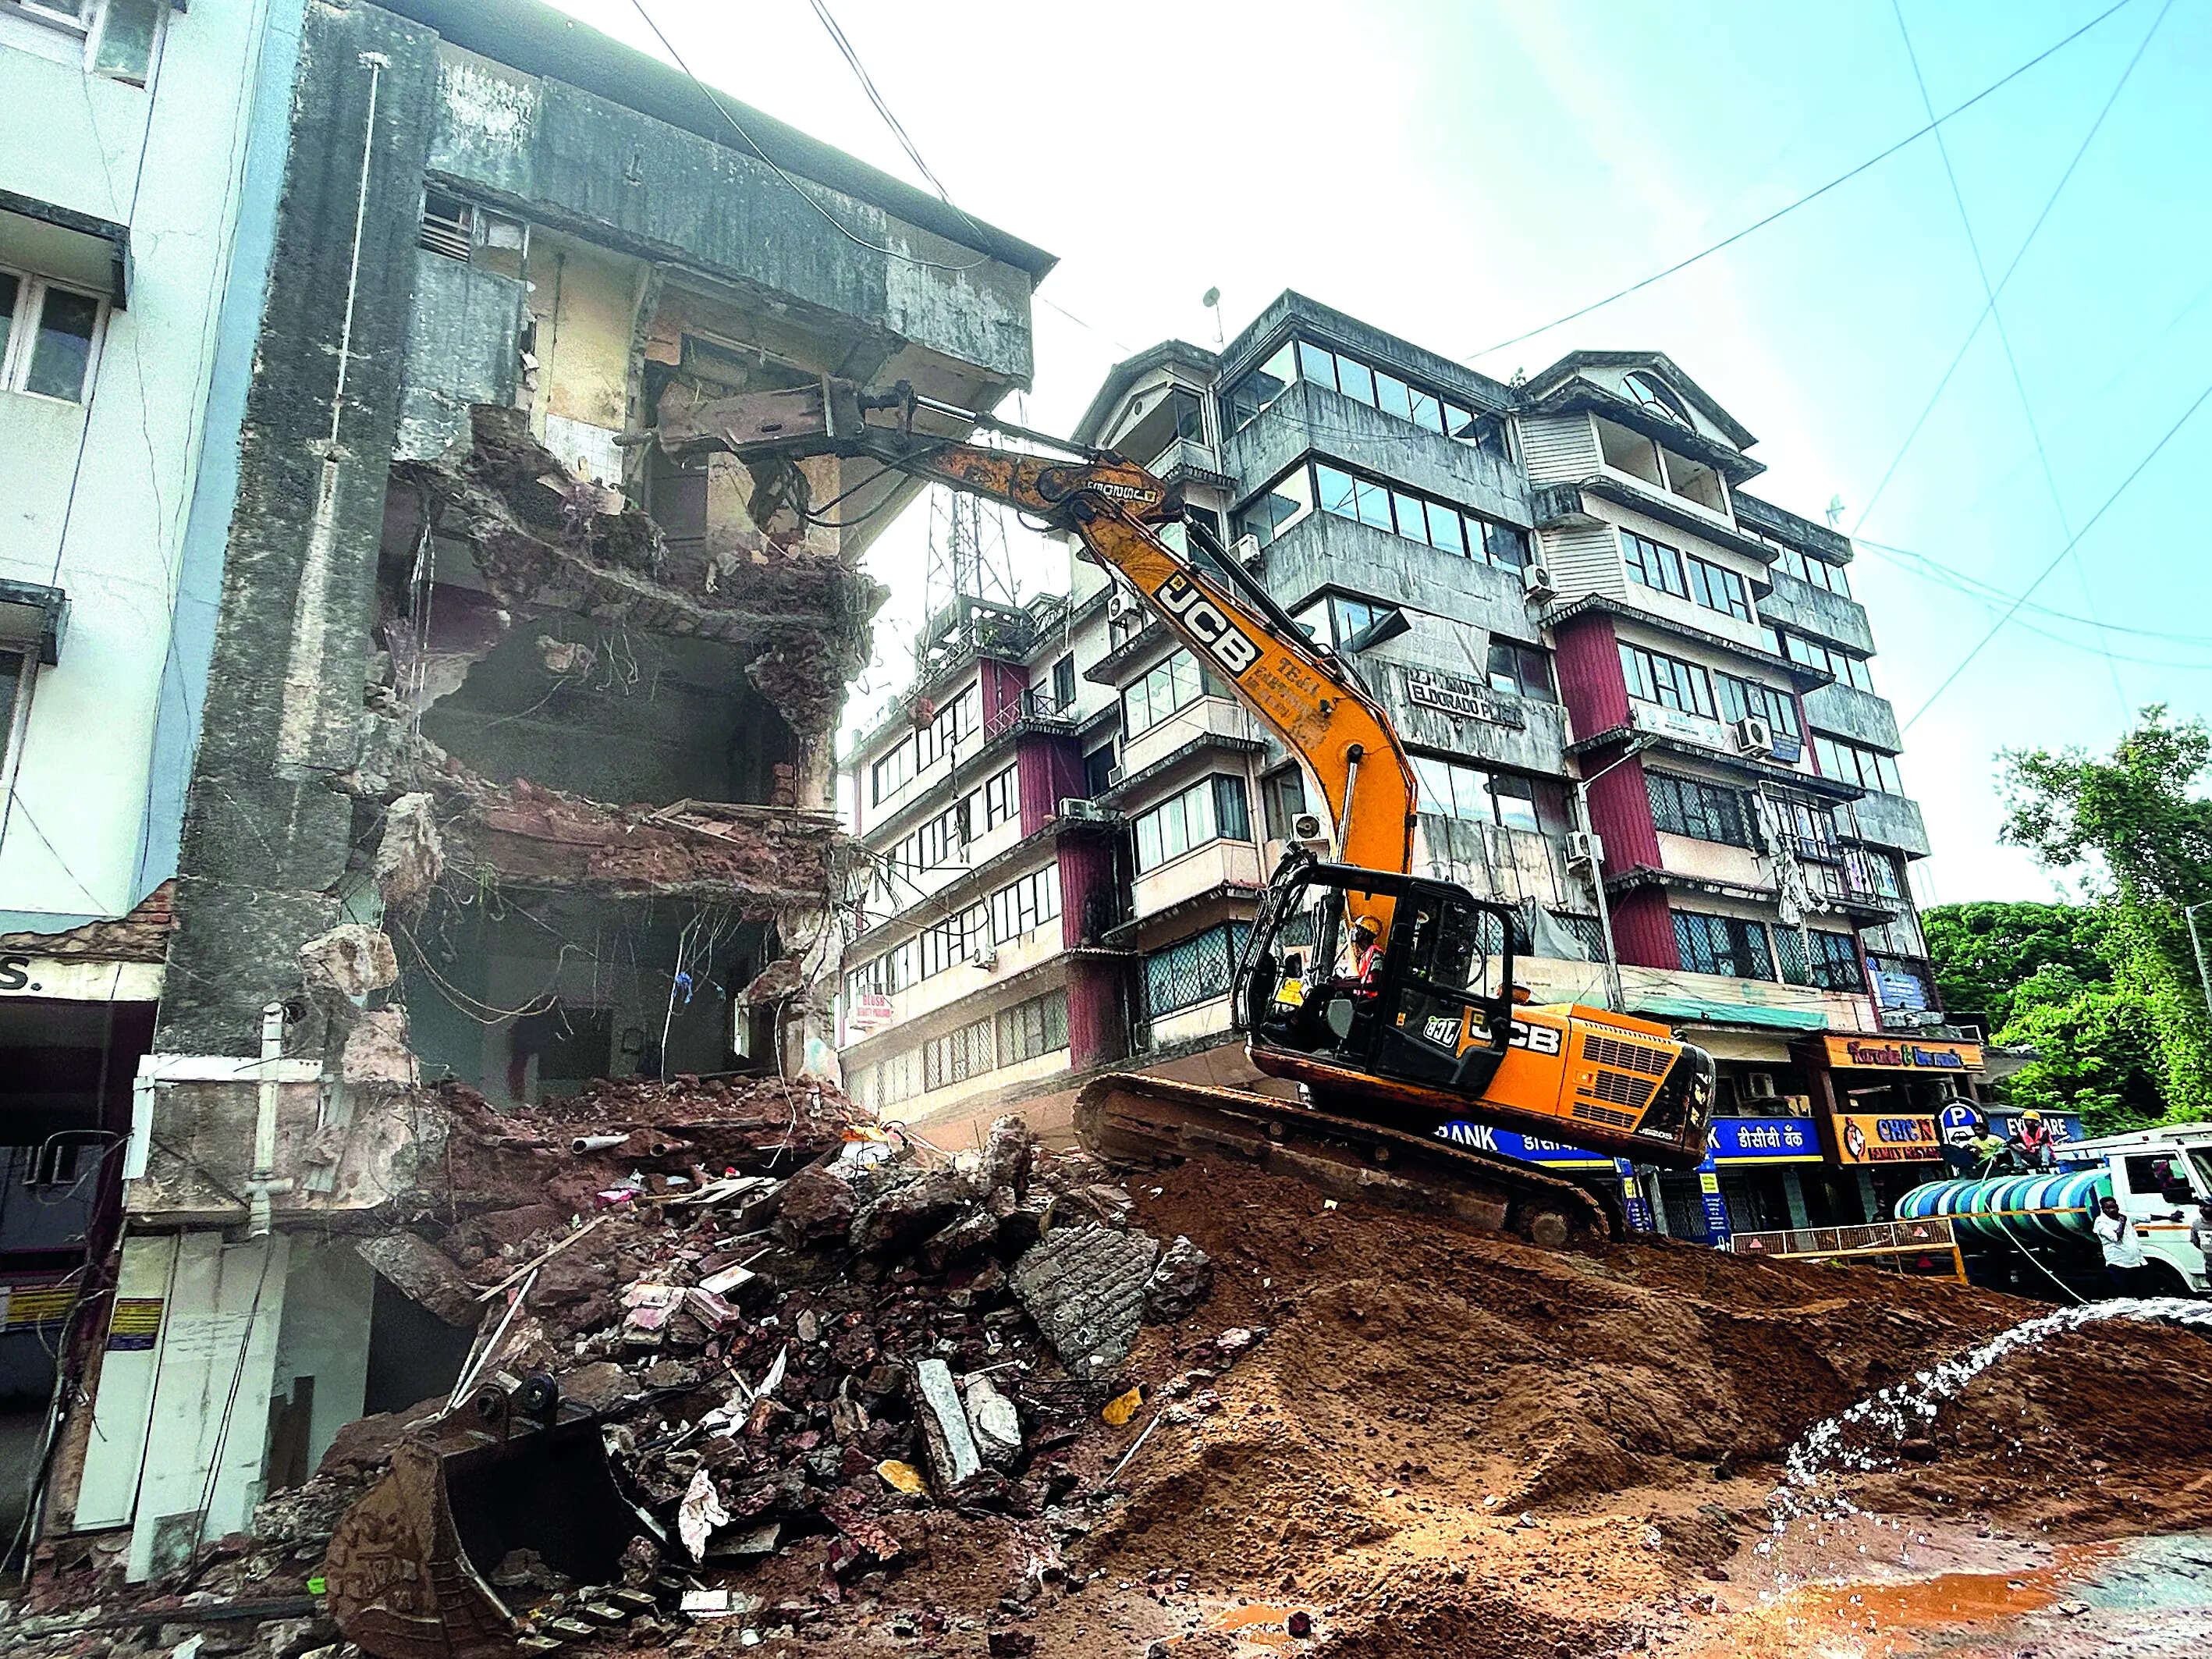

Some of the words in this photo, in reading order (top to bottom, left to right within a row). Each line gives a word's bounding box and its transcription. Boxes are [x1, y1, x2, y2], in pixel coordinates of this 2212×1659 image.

[1159, 585, 1256, 672] JCB
[1411, 684, 1479, 714] ELDORADO
[1950, 1107, 1966, 1126] P
